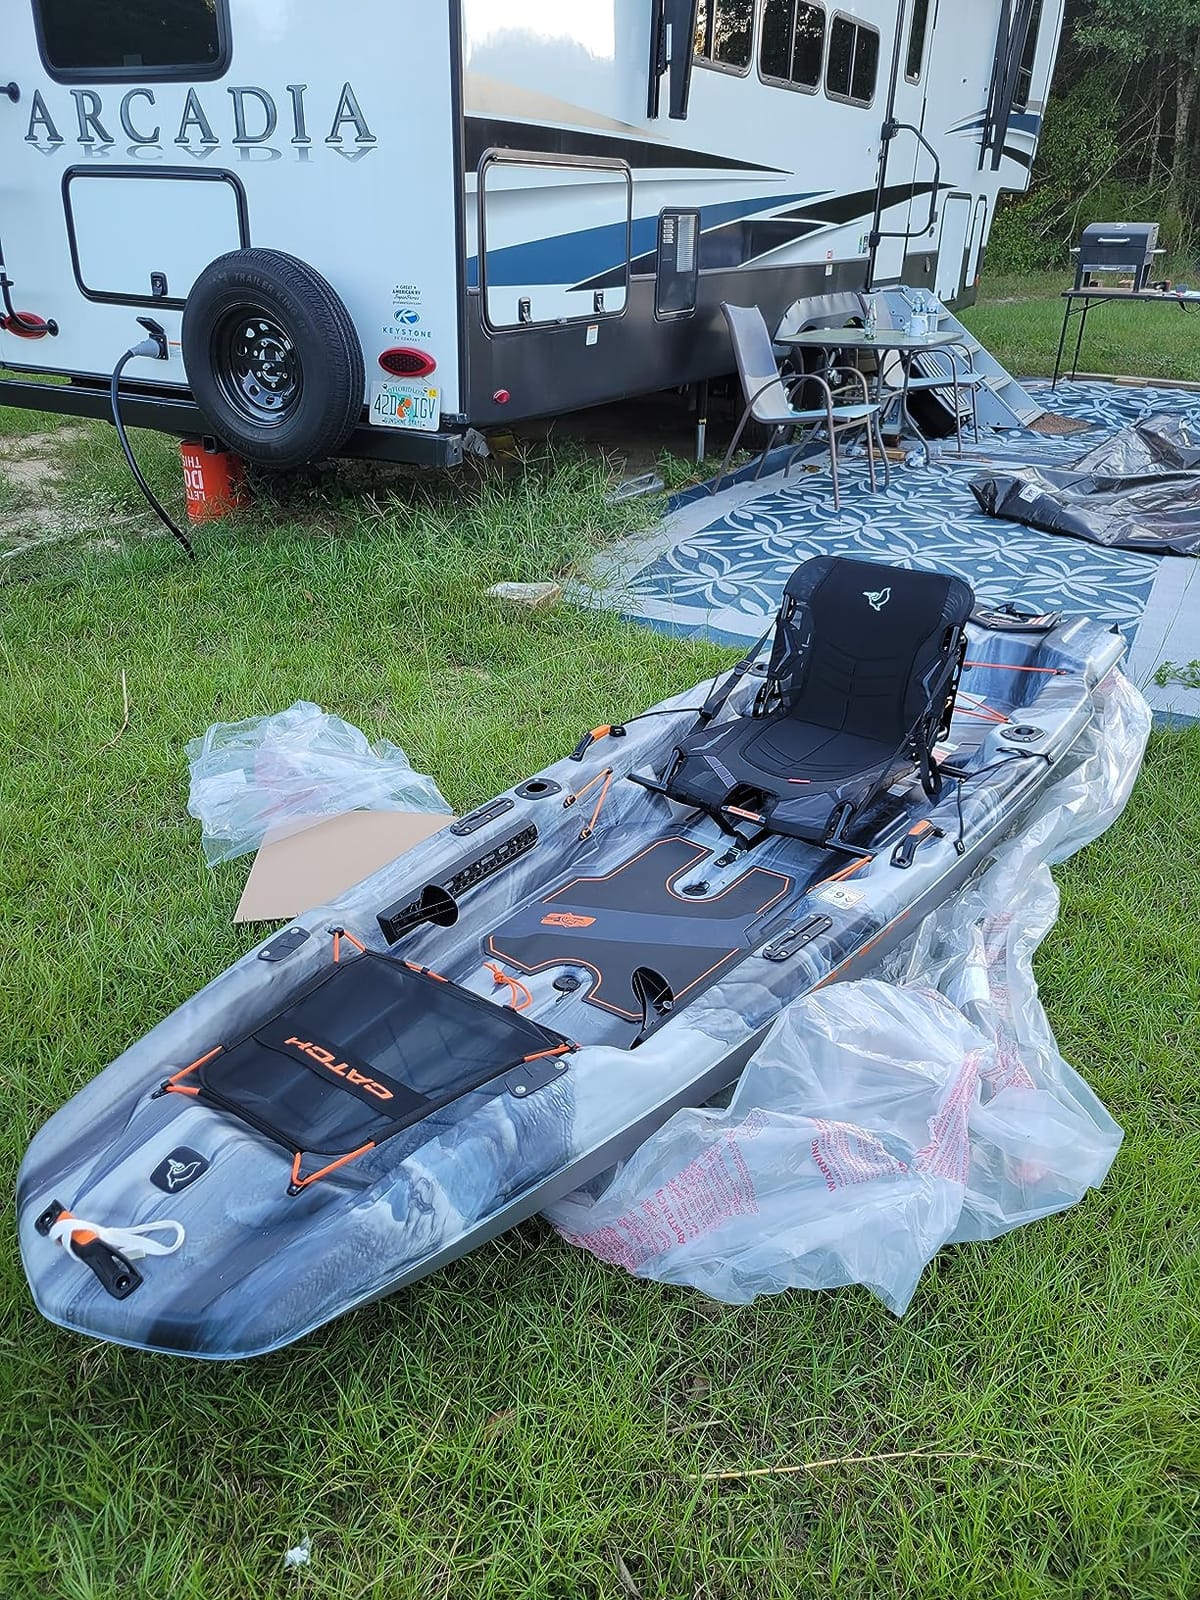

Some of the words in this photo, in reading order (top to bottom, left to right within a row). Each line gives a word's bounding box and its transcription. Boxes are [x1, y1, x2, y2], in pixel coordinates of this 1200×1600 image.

[24, 82, 377, 144] ARCADIA
[382, 326, 432, 338] KEYSTONE
[373, 393, 397, 416] 42D
[413, 397, 436, 419] IGV
[184, 469, 204, 490] DO
[284, 1036, 394, 1100] CATCH
[811, 1138, 836, 1192] WARNING
